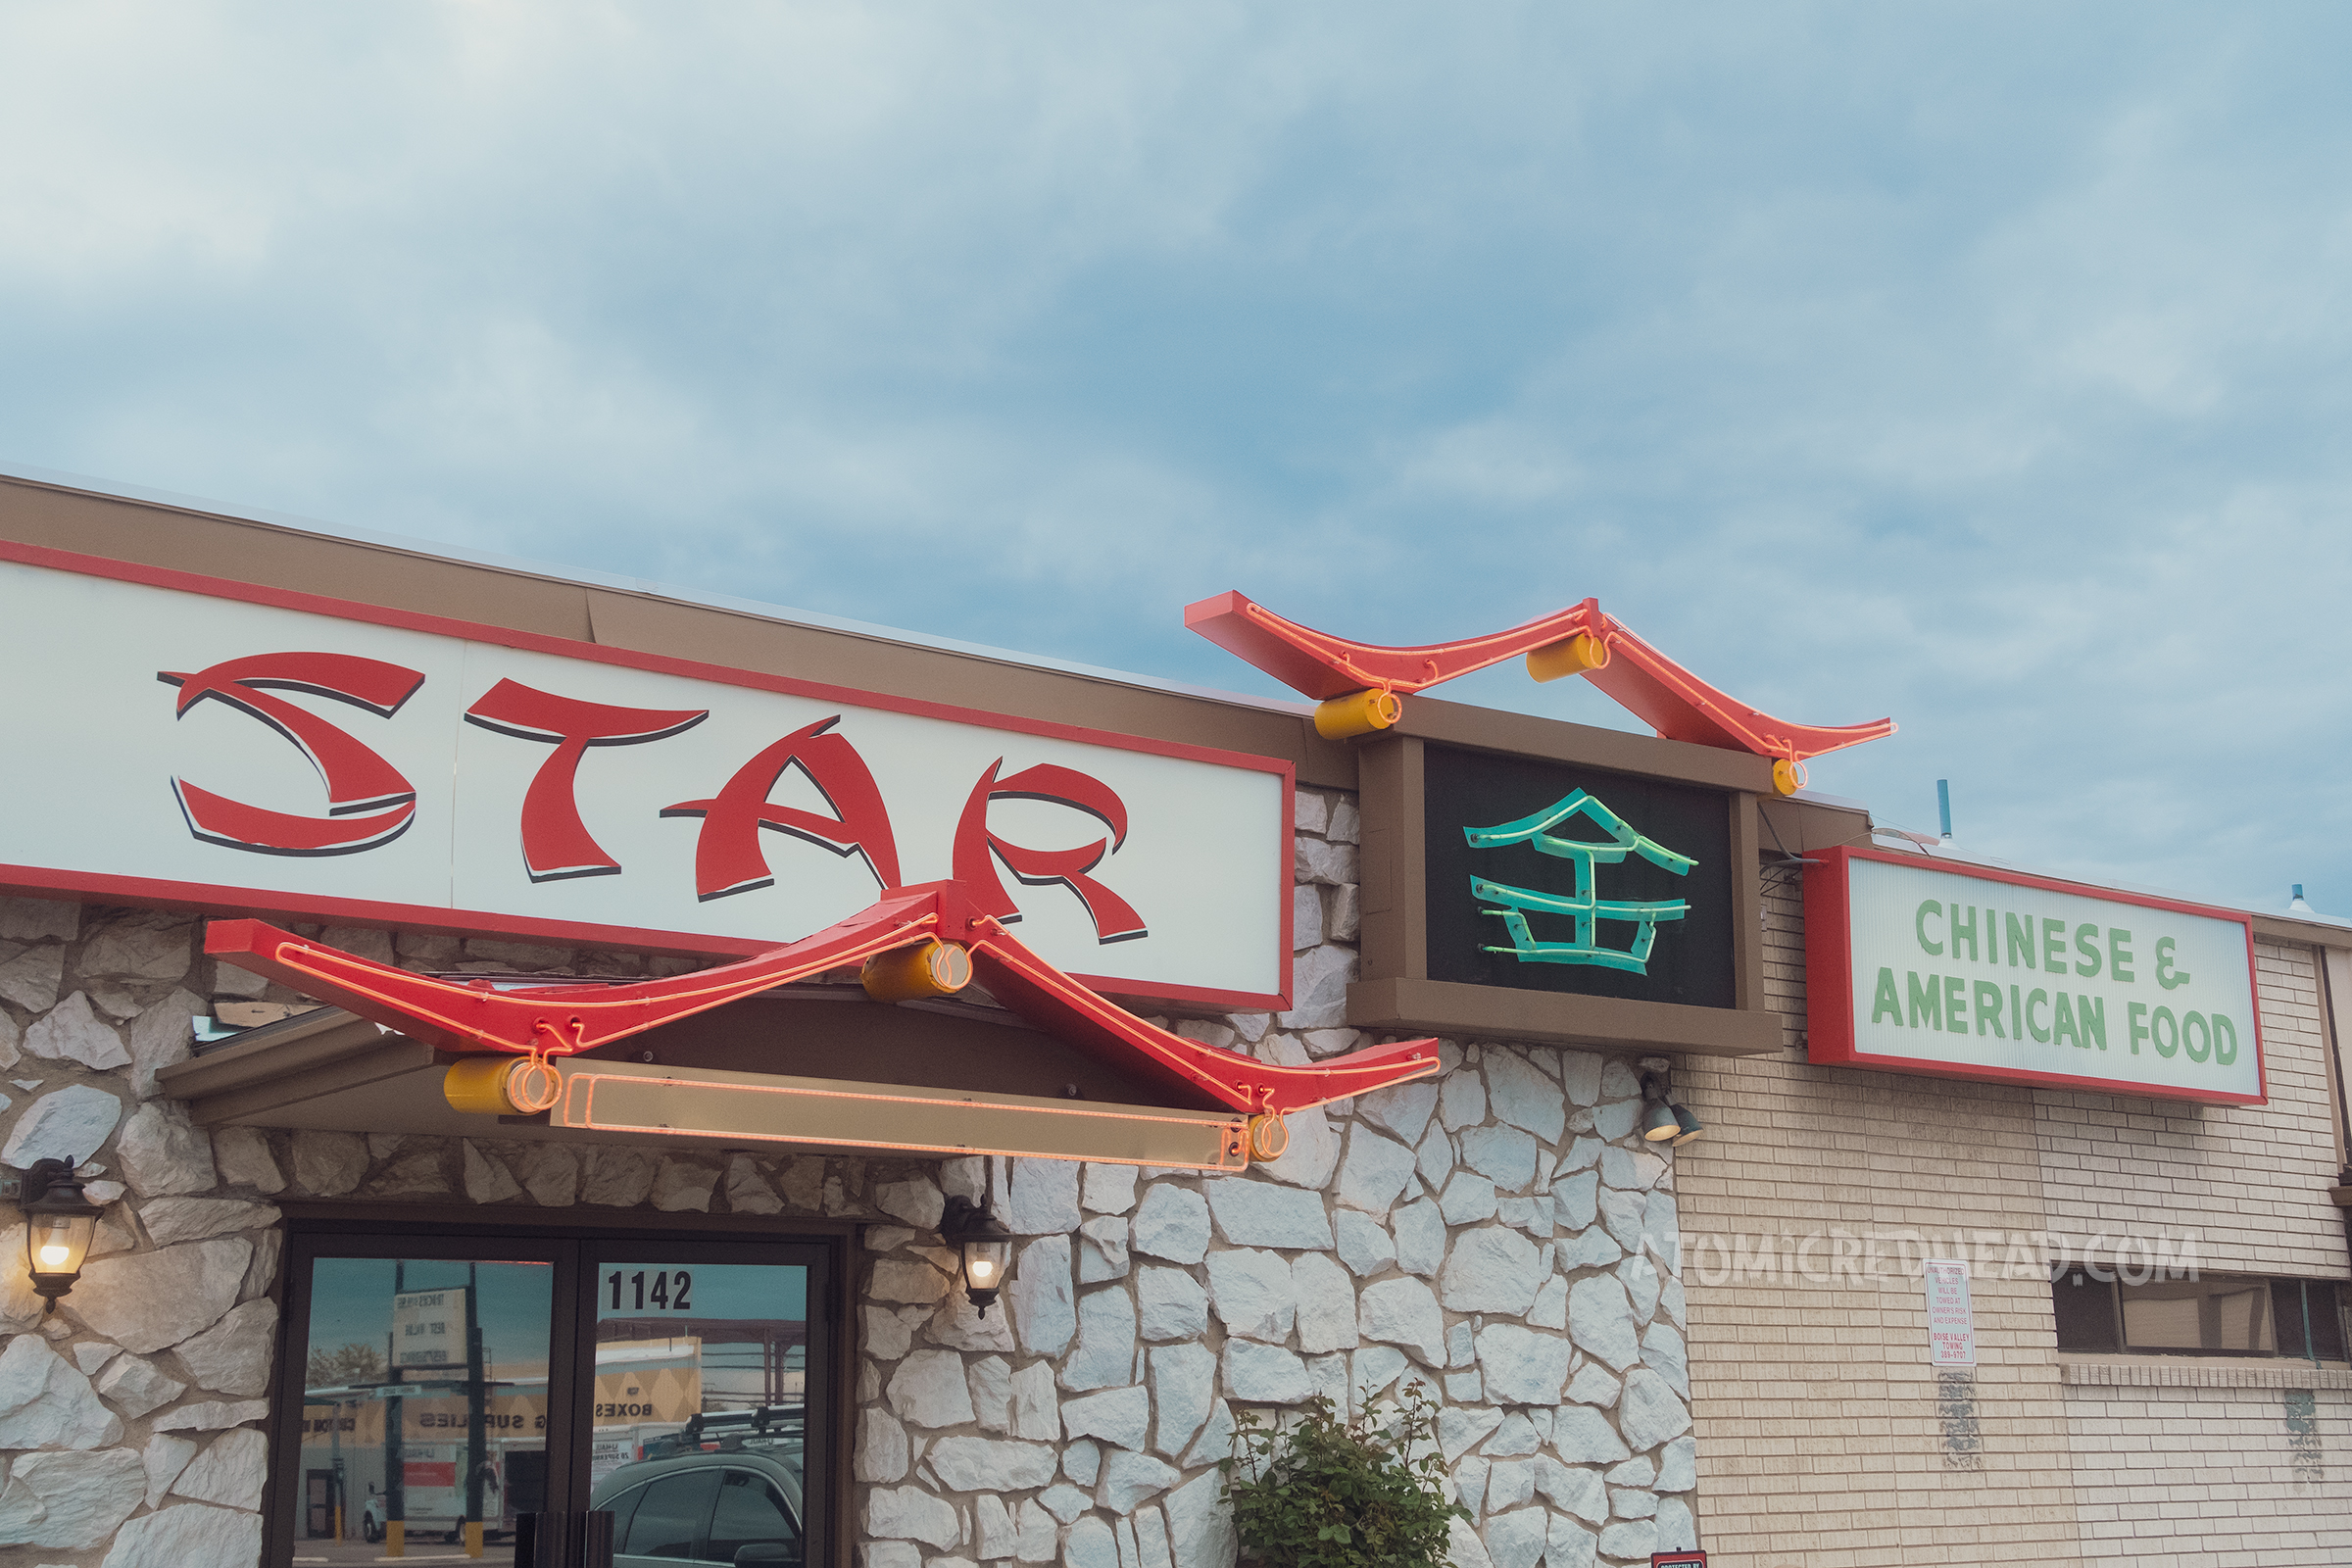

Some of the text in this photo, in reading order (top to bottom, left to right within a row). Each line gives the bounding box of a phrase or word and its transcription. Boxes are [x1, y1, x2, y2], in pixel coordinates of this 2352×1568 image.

[157, 652, 1149, 944] STAR
[1916, 899, 2190, 990] CHINESE &
[1872, 966, 2237, 1065] AMERICAN FOOD
[1928, 1266, 1964, 1275] UNAUTHORIZED
[609, 1271, 691, 1309] 1142
[1934, 1332, 1970, 1342] BOISE VALLEY
[1941, 1342, 1964, 1350] TOWING
[1940, 1350, 1966, 1359] 389-9707
